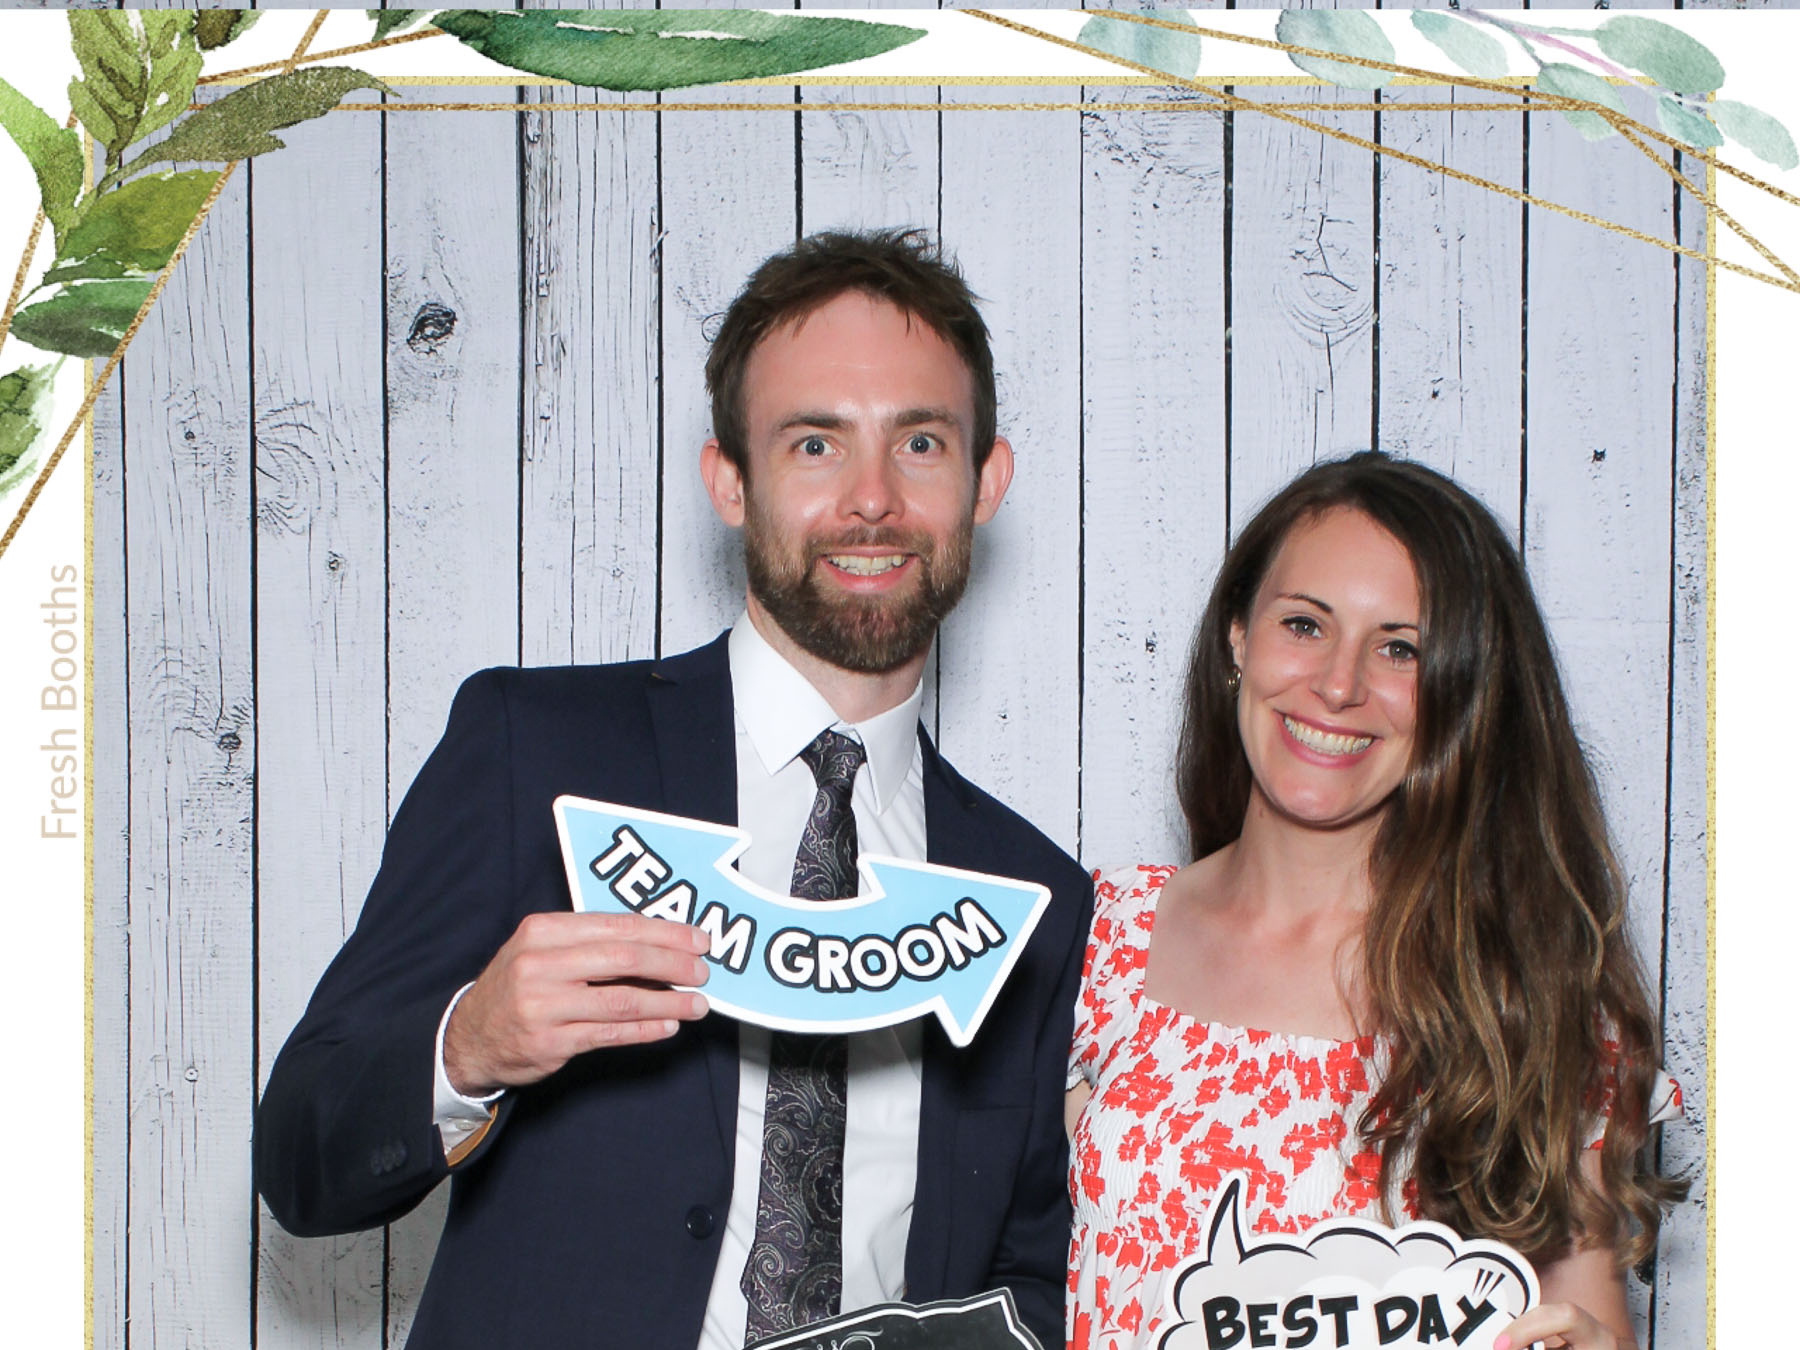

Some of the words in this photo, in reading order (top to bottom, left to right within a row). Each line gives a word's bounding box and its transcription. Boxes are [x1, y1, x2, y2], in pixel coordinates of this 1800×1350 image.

[589, 824, 757, 973] TEAM
[764, 897, 1007, 992] GROOM
[1374, 1293, 1497, 1346] DAY
